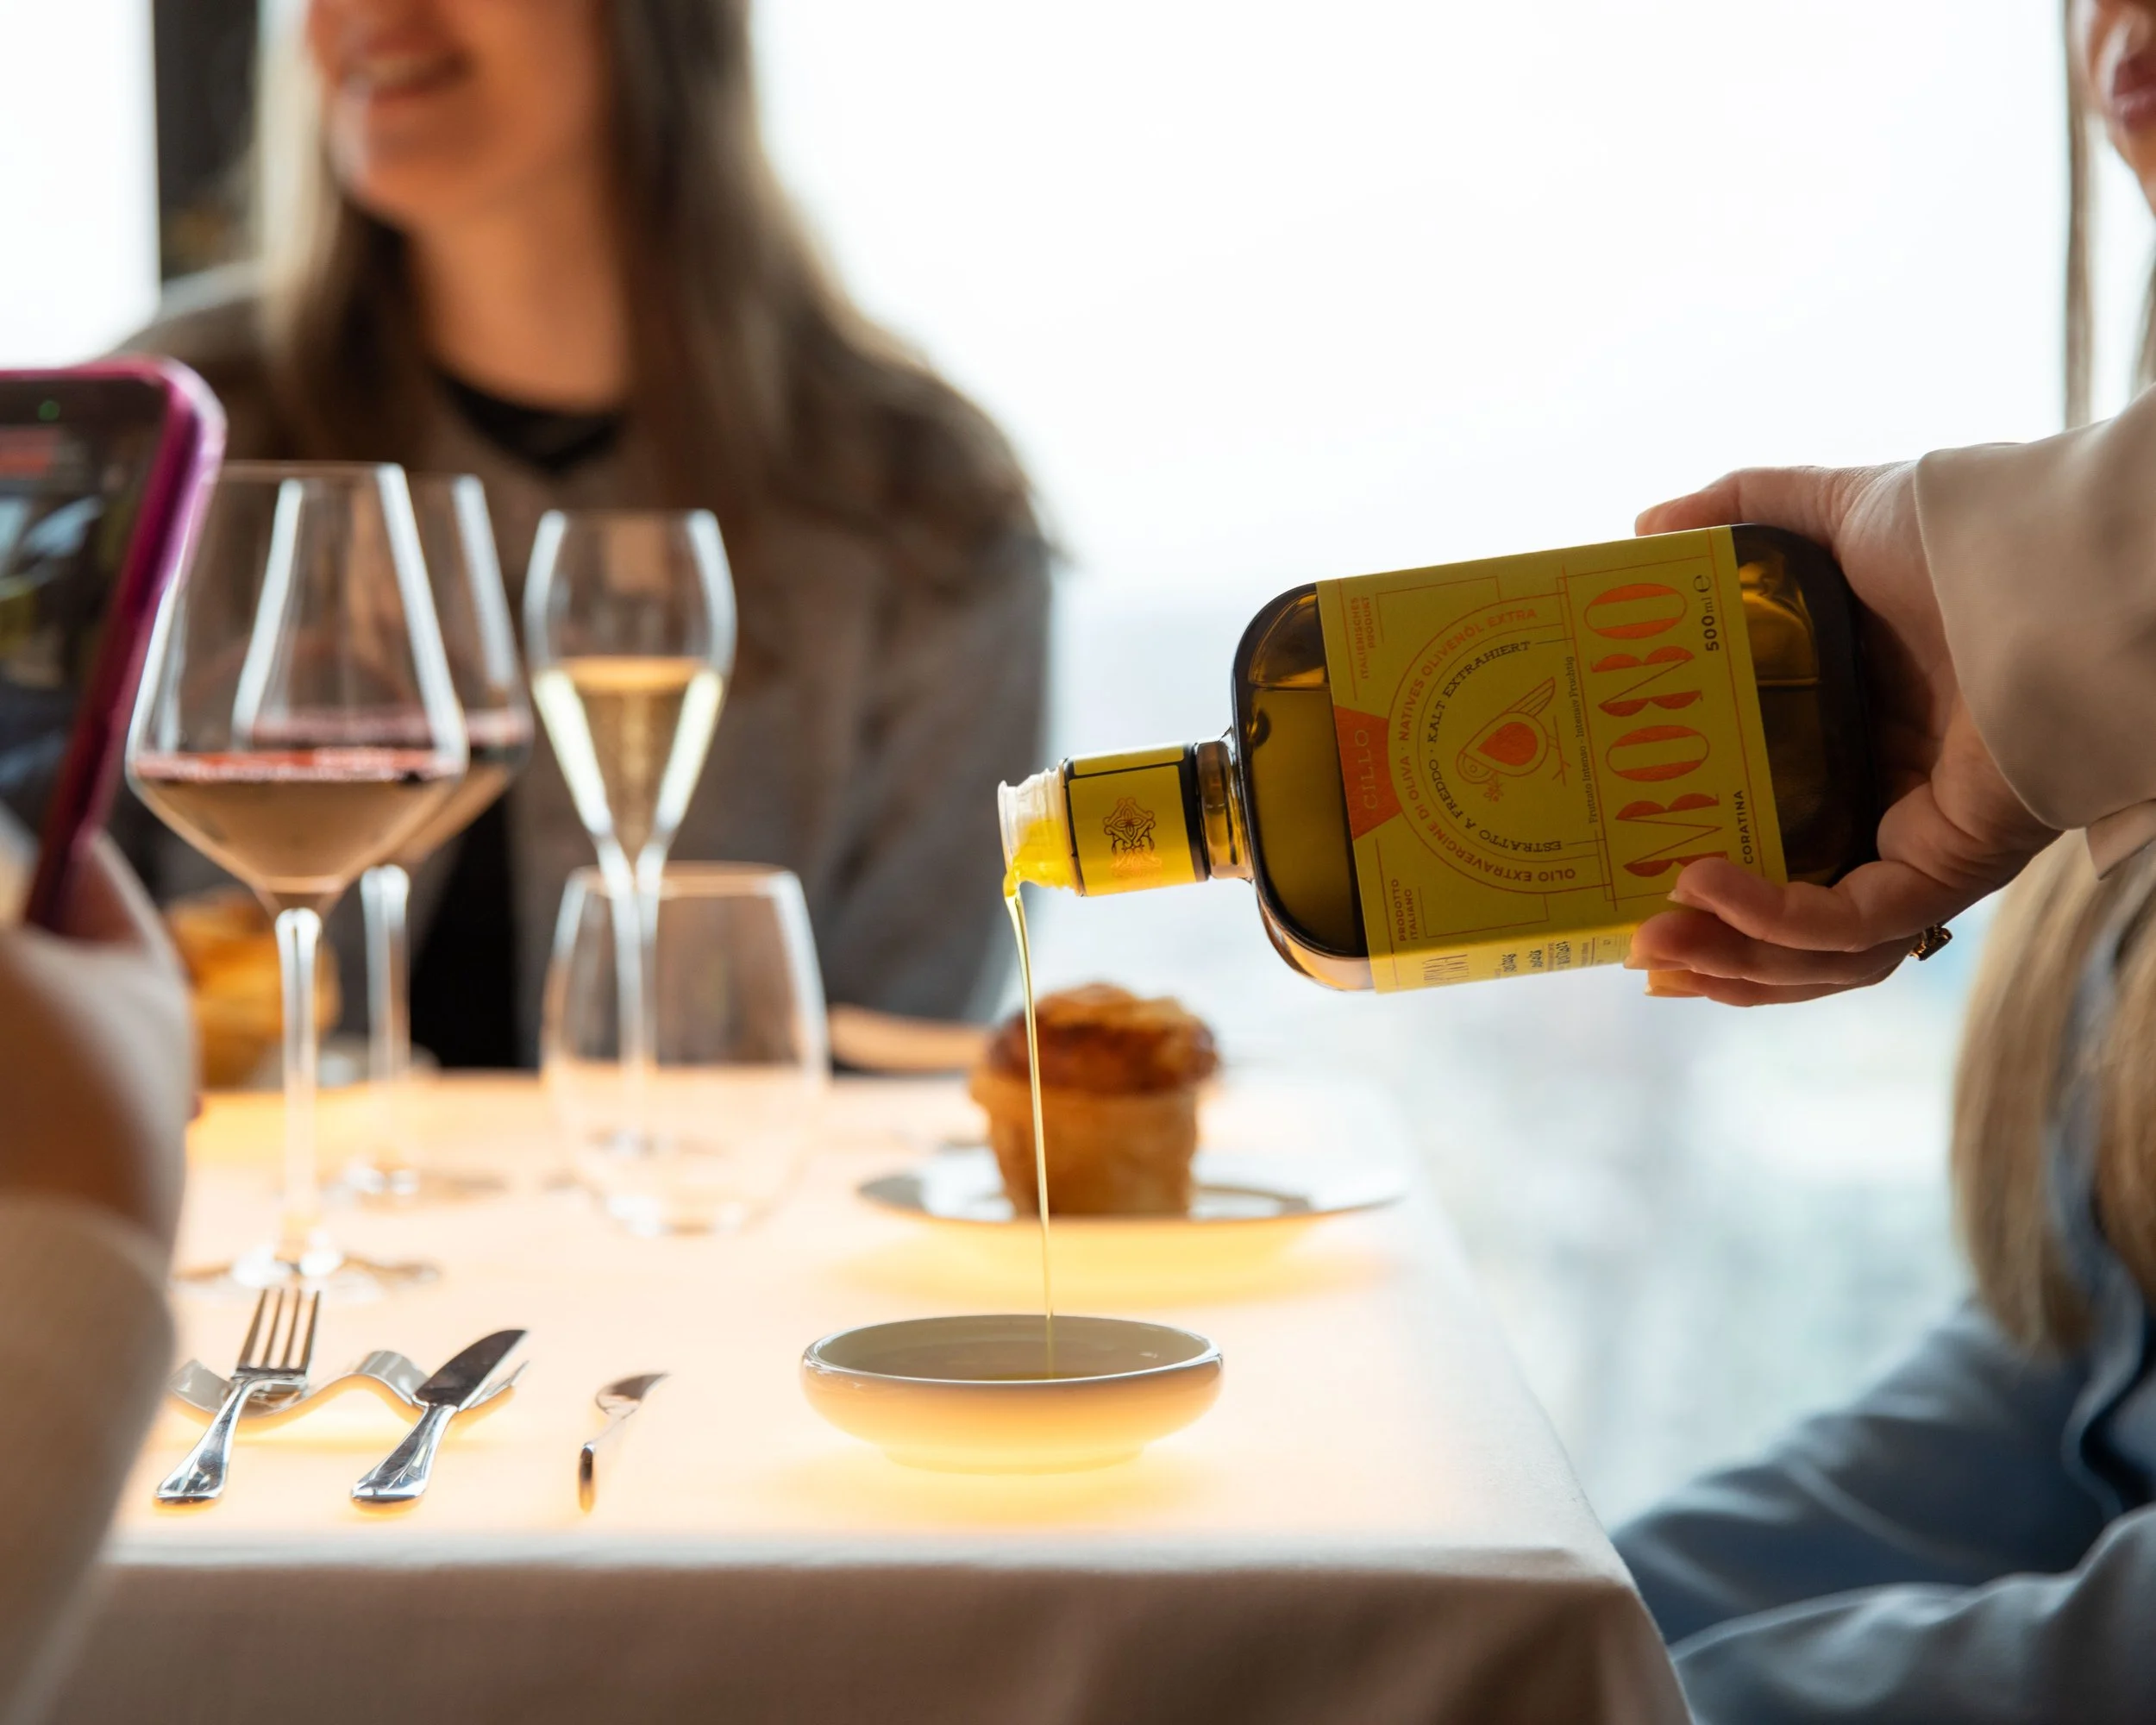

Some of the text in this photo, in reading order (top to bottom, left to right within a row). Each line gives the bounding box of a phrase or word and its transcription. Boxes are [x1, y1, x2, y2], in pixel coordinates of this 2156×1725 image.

[1351, 597, 1369, 680] ITALIENISCHES
[1362, 596, 1376, 648] PRODUKT
[1355, 730, 1378, 810] CILLO
[1399, 608, 1576, 882] OLIO EXTRAVERGINE DI OLIVA NATIVES OLIVENÖL EXTRA
[1427, 640, 1563, 853] ESTRATTO A FREDDO KALT EXTRAHIERT
[1566, 656, 1597, 824] Fruttato Intenso Intensiv Fruchtig
[1584, 583, 1728, 877] MONO
[1733, 790, 1754, 865] CORATINA
[1391, 878, 1407, 942] PRODOTTO
[1404, 889, 1419, 940] ITALIANO
